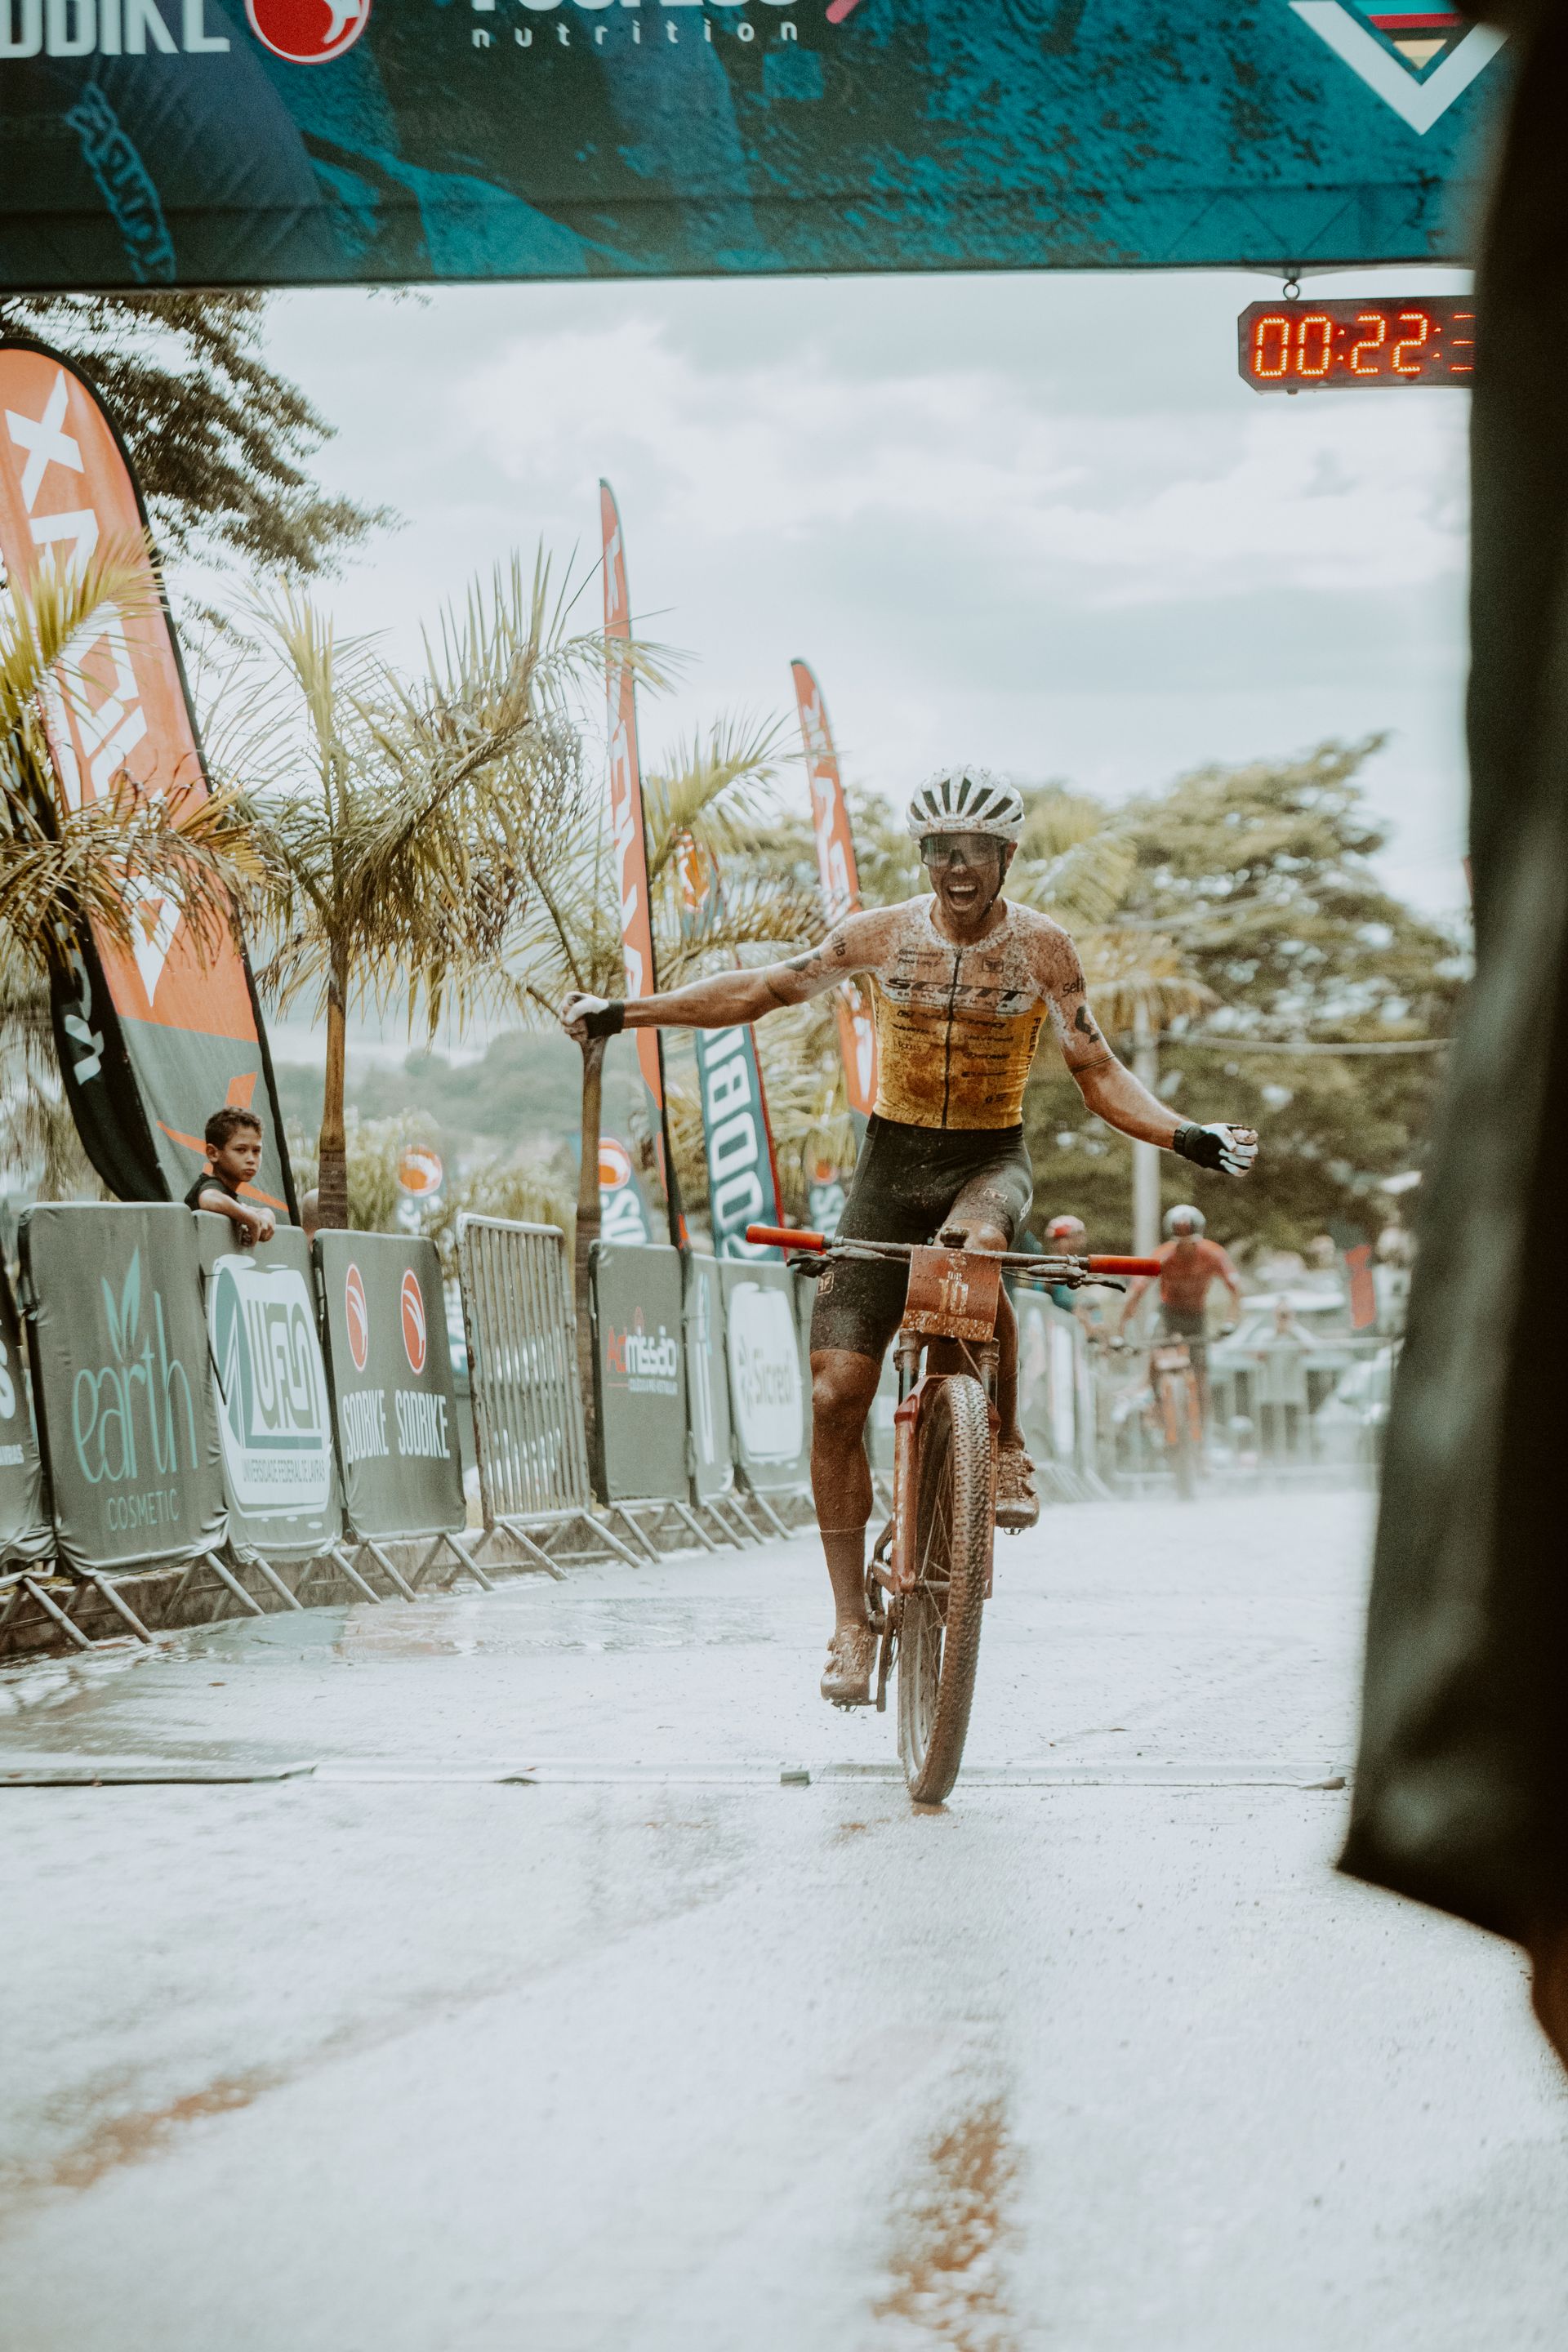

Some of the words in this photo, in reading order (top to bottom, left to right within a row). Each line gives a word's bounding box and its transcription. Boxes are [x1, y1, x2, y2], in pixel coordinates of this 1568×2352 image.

[471, 18, 799, 48] nutrition
[885, 978, 1028, 1003] SCOTT
[72, 1290, 198, 1484] earth
[342, 1389, 390, 1463] SODBIKE
[395, 1389, 450, 1459] SODBIKE
[108, 1489, 180, 1531] COSMETIC
